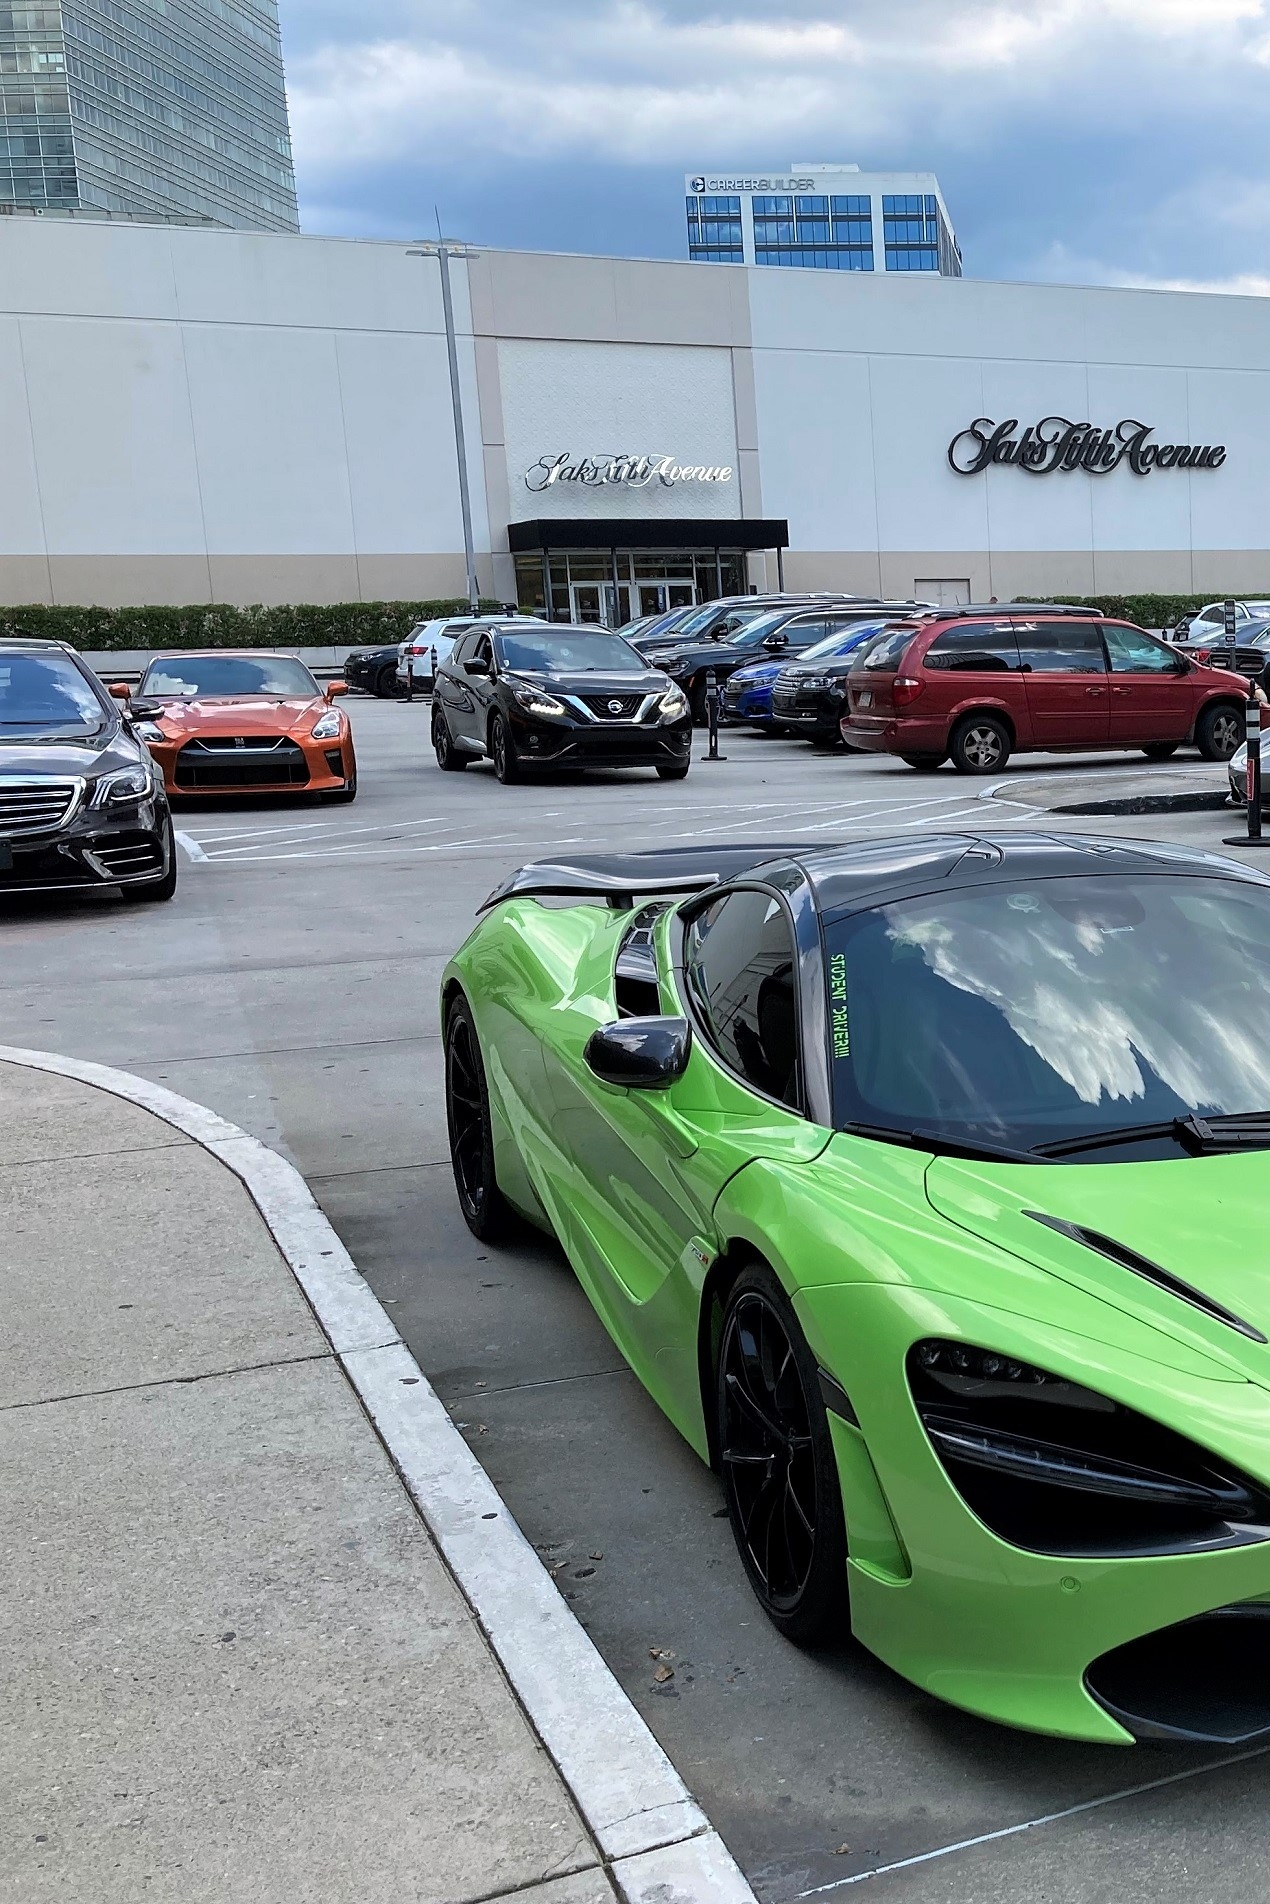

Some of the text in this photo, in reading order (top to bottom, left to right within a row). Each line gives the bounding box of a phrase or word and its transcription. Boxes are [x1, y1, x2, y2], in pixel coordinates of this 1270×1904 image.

[707, 178, 816, 191] CAREERBUILDER
[948, 416, 1227, 475] Saks Fifth Avenue
[525, 452, 733, 492] Saks Fifth Avenue
[830, 953, 850, 1058] STUDENT DRIVER!!!
